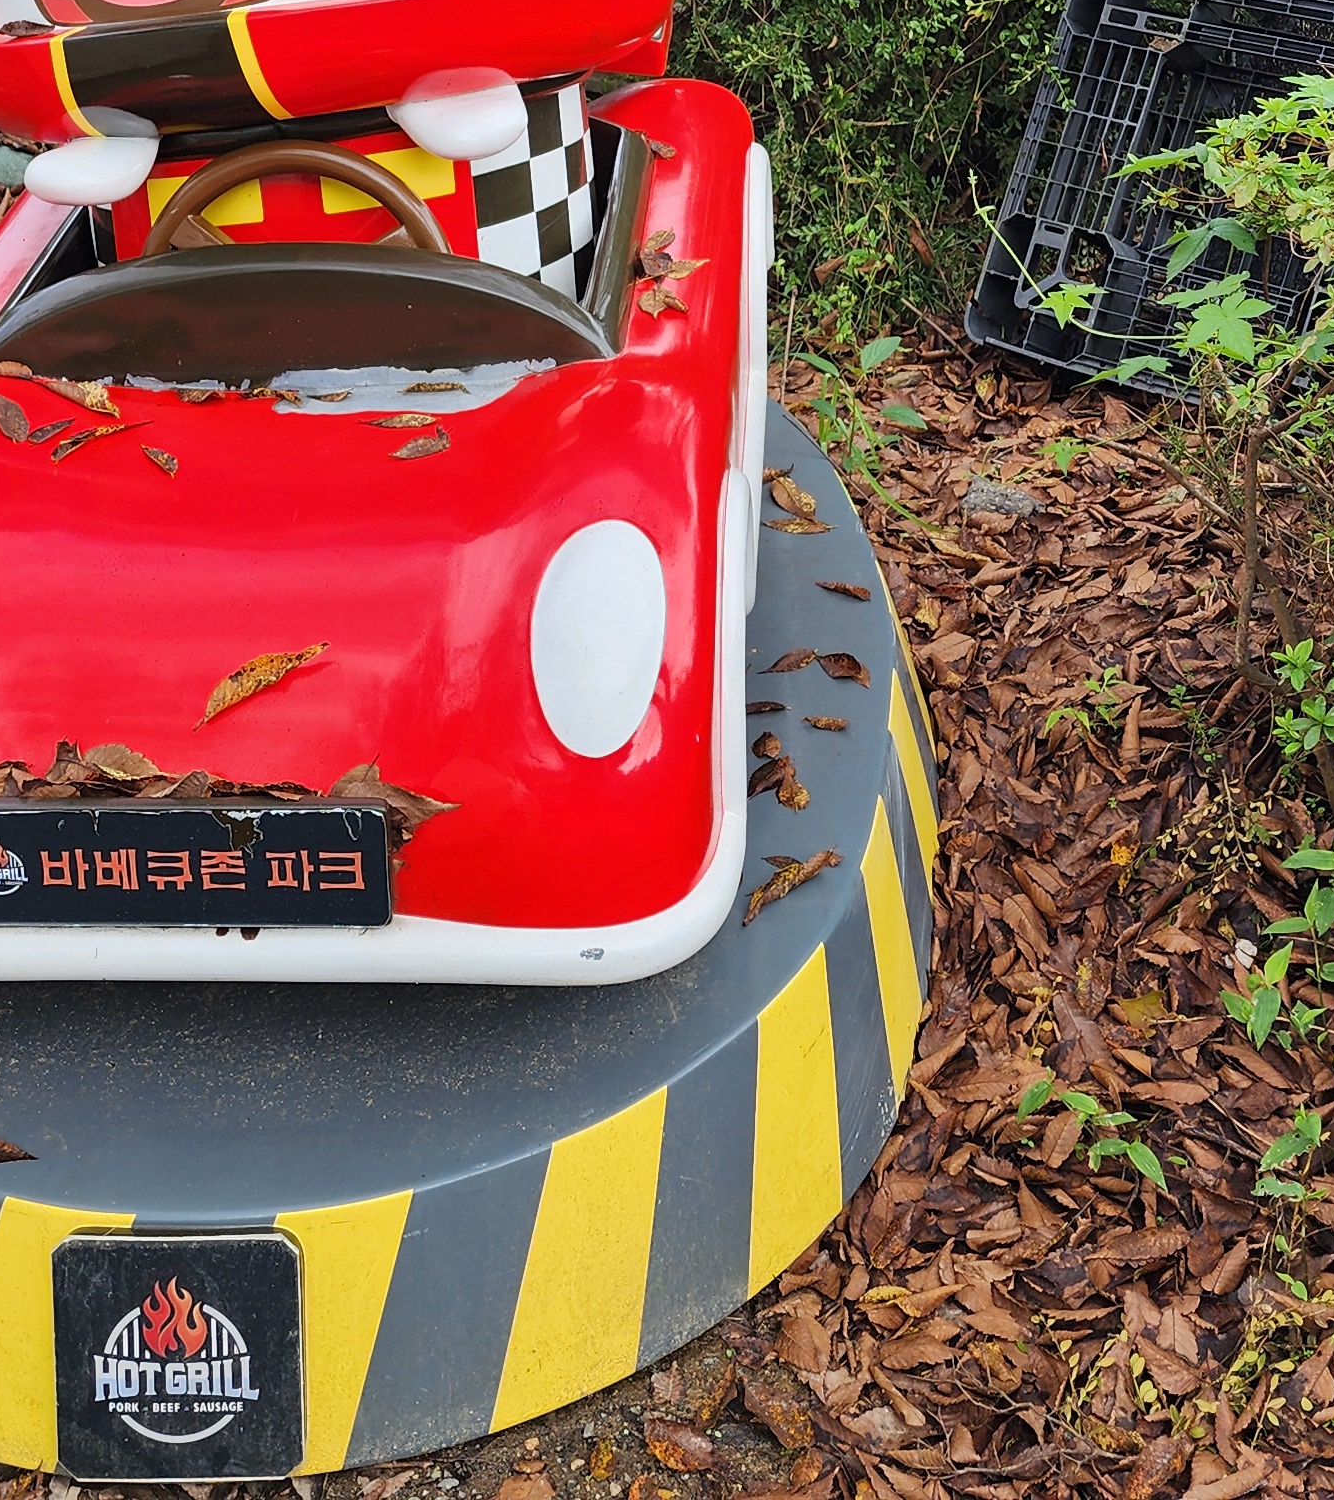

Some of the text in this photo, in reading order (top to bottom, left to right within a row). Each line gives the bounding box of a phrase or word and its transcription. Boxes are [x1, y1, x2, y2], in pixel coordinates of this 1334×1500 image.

[40, 849, 365, 891] 바베큐존 파크
[93, 1355, 260, 1401] HOT GRILL
[108, 1402, 244, 1413] PORK BEEF SAUSAGE
